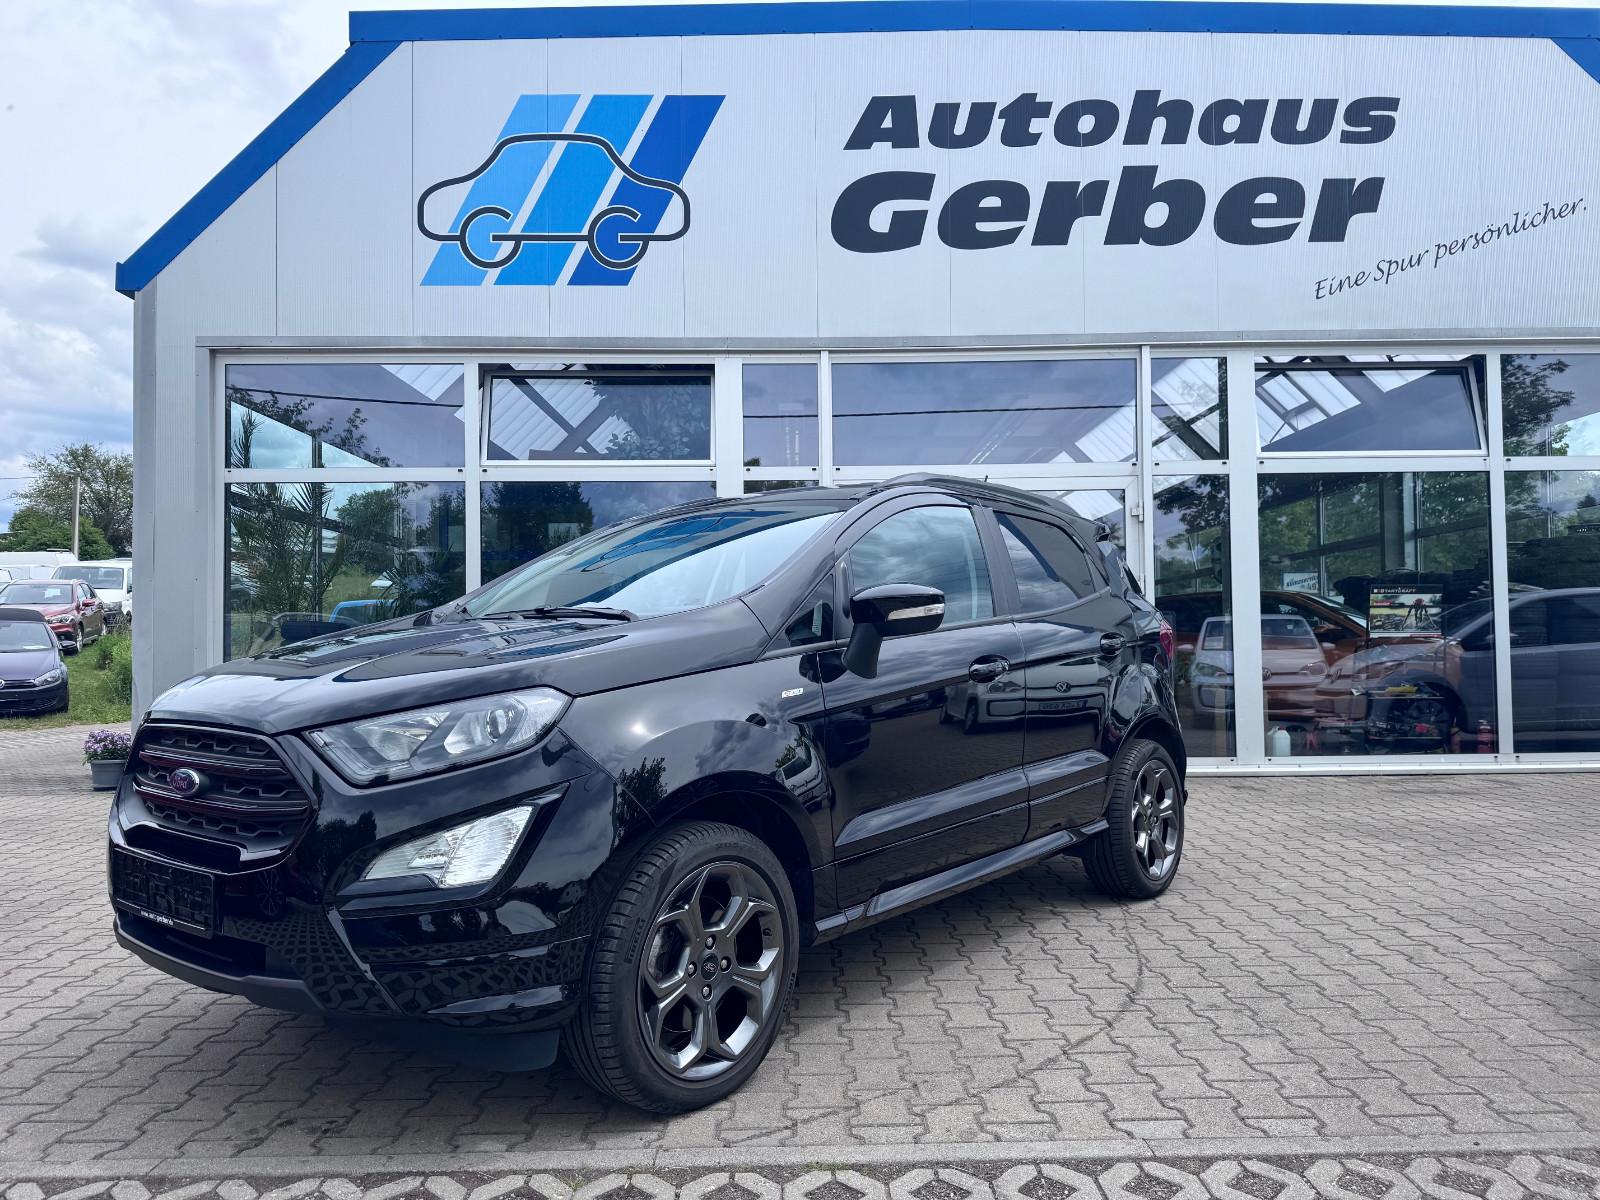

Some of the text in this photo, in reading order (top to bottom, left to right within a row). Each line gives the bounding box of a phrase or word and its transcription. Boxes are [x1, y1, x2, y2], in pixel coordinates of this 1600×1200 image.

[843, 90, 1400, 150] Autohaus
[831, 165, 1385, 253] Gerber
[1314, 197, 1588, 300] Eine Spur persönlicher.
